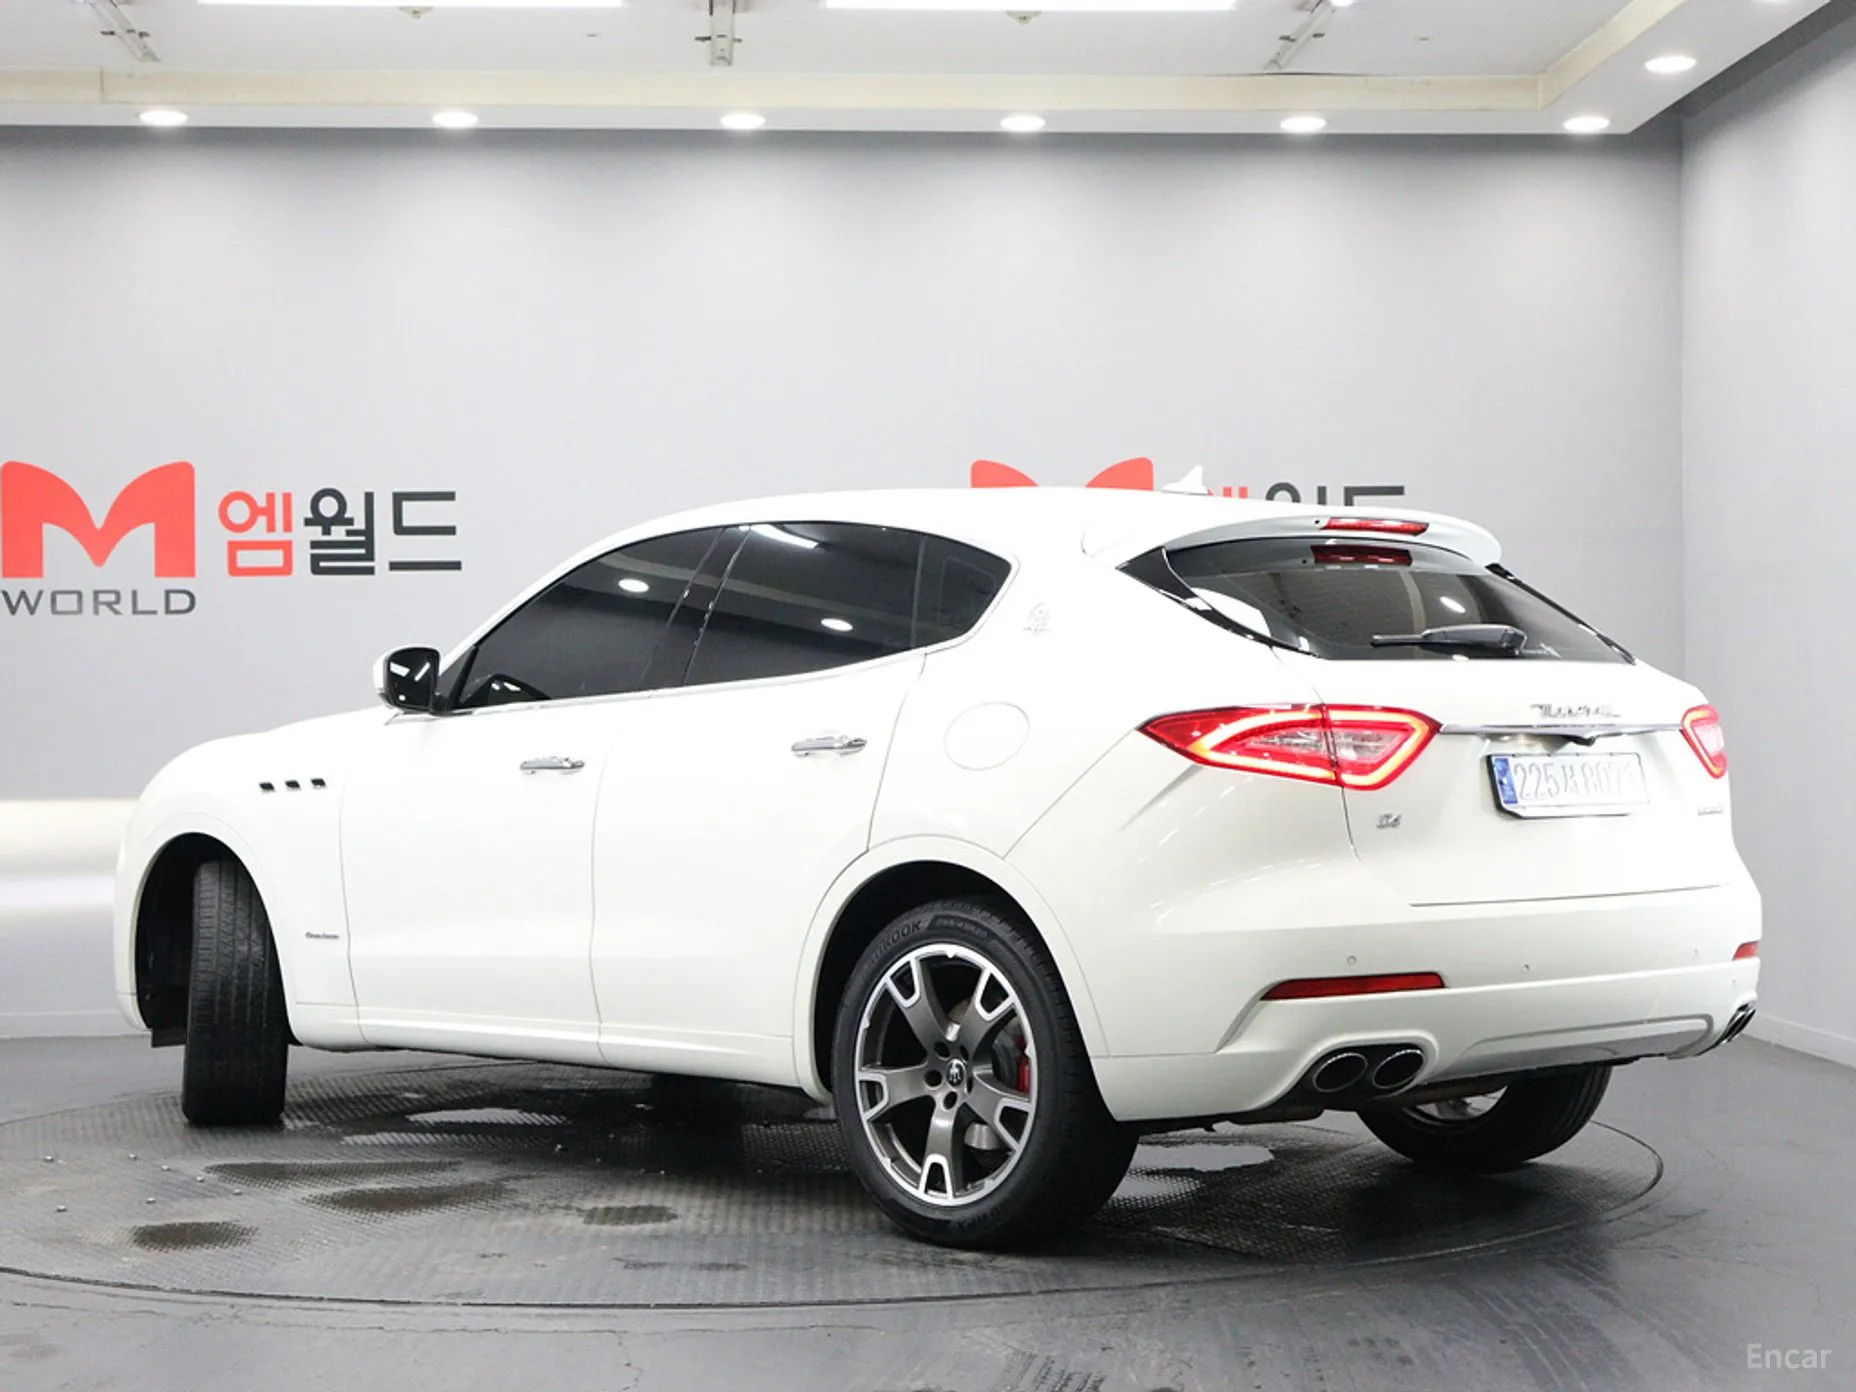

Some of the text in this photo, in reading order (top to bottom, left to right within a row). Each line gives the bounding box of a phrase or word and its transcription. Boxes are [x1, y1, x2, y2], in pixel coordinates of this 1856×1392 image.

[1, 461, 196, 578] M
[218, 487, 462, 576] 엠월드
[1, 589, 197, 616] WORLD
